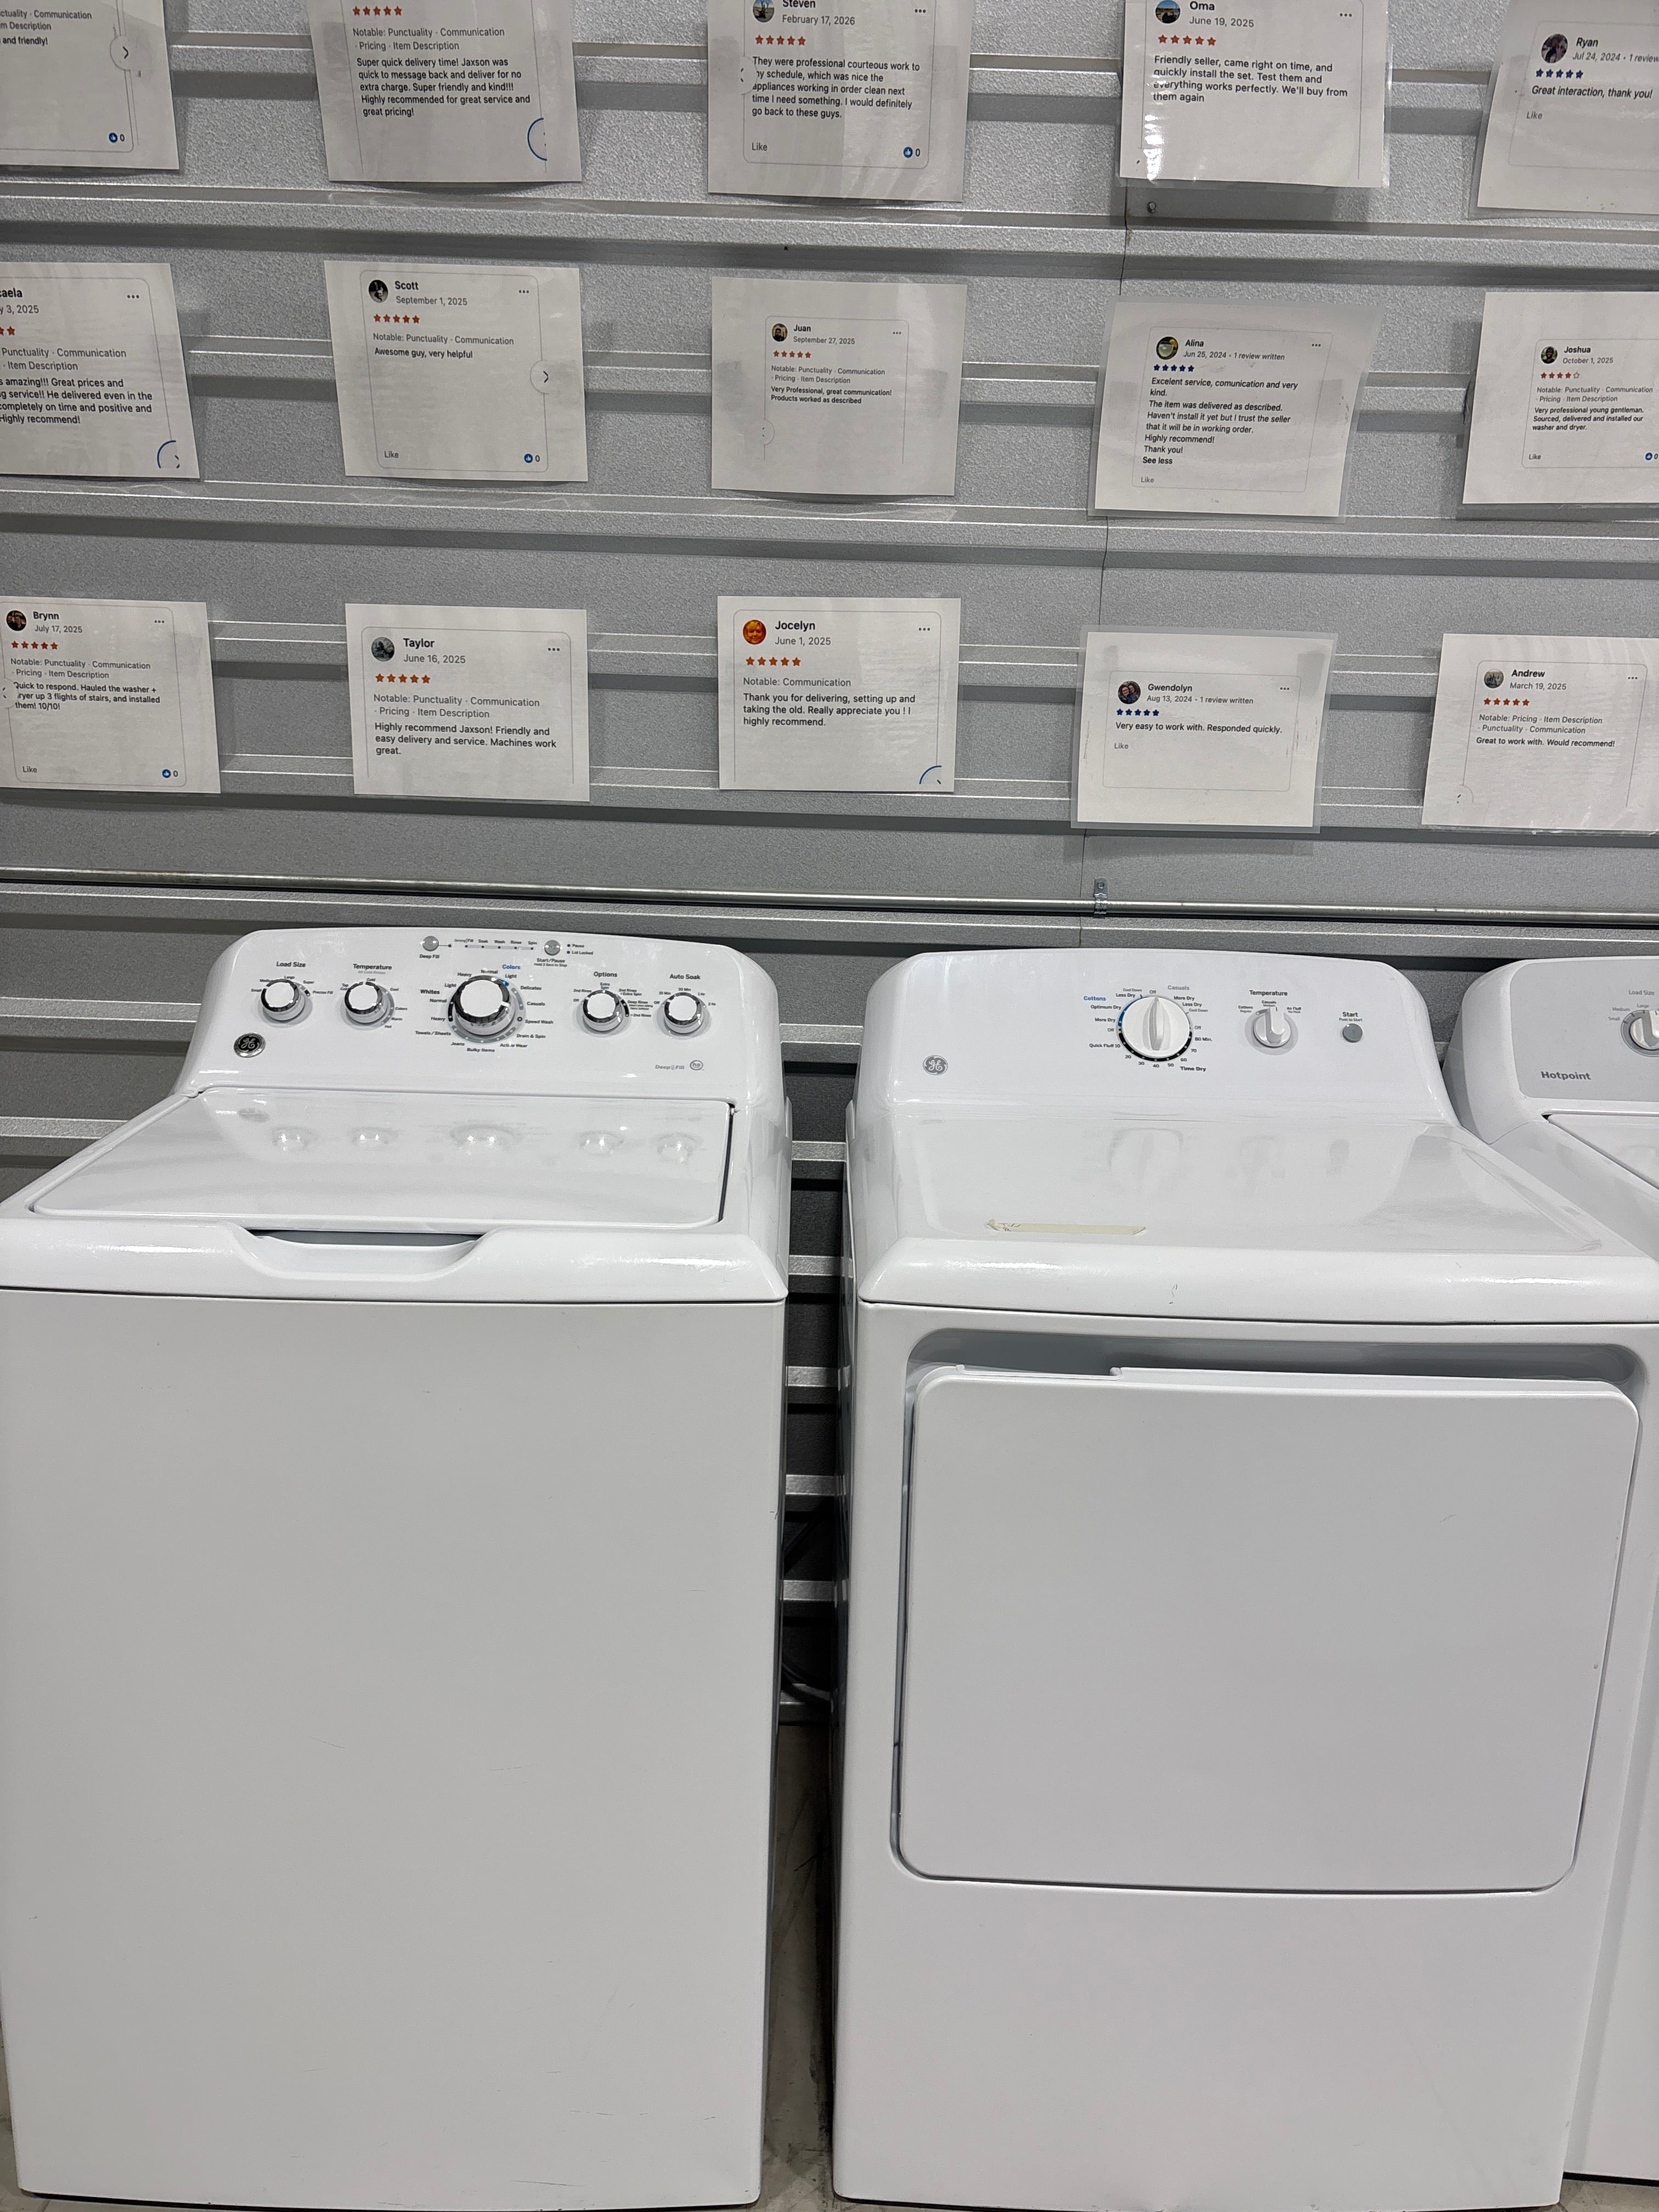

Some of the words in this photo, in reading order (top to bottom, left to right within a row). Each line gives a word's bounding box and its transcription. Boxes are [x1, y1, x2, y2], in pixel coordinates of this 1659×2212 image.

[783, 0, 815, 8] Steven
[1190, 1, 1215, 10] Oma
[782, 14, 819, 25] February
[821, 16, 831, 26] 17,
[834, 16, 855, 25] 2026
[1189, 16, 1211, 25] June
[1215, 18, 1227, 27] 19,
[1231, 18, 1254, 27] 2025
[2, 36, 16, 44] and
[18, 36, 48, 47] friendly!
[1576, 37, 1598, 48] Ryan
[357, 58, 379, 68] Super
[381, 58, 403, 68] quick
[405, 58, 436, 68] delivery
[438, 58, 459, 66] time!
[461, 58, 490, 66] Jaxson
[1155, 55, 1192, 66] Friendly
[1194, 57, 1221, 67] seller,
[1252, 60, 1273, 70] right
[1290, 61, 1312, 72] time,
[1316, 64, 1333, 72] and
[1532, 85, 1556, 95] Great
[1558, 86, 1605, 98] interaction,
[1608, 88, 1632, 98] thank
[1633, 89, 1653, 99] you!
[363, 108, 383, 117] great
[385, 107, 414, 117] pricing!
[752, 108, 762, 116] go
[765, 107, 783, 116] back
[786, 108, 794, 116] to
[796, 108, 819, 117] these
[821, 111, 842, 120] guys.
[752, 142, 768, 151] Like
[915, 148, 921, 157] 0
[394, 281, 419, 290] Scott
[396, 296, 437, 305] September
[439, 297, 445, 306] 1,
[448, 297, 467, 306] 2025
[2, 348, 49, 358] Punctuality
[57, 348, 126, 357] Communication
[375, 347, 409, 356] Awesome
[411, 350, 427, 358] guy,
[447, 349, 473, 359] helpful
[1144, 445, 1166, 453] Thank
[1167, 447, 1183, 455] you!
[33, 611, 59, 621] Brynn
[35, 625, 49, 633] July
[52, 625, 61, 634] 17,
[775, 620, 815, 632] Jocelyn
[403, 638, 435, 650] Taylor
[775, 636, 796, 645] June
[799, 637, 805, 646] 1,
[809, 637, 831, 645] 2025
[403, 654, 425, 662] June
[427, 654, 439, 664] 16,
[443, 655, 466, 663] 2025
[1511, 669, 1545, 678] Andrew
[743, 677, 780, 686] Notable:
[783, 678, 851, 686] Communication
[1535, 682, 1545, 691] 19,
[1148, 684, 1192, 693] Gwendolyn
[38, 702, 60, 711] 10/10!
[744, 716, 770, 727] highly
[772, 718, 826, 726] recommend.
[375, 722, 403, 732] Highly
[459, 725, 493, 733] Jaxson!
[496, 726, 531, 737] Friendly
[533, 727, 550, 736] and
[1116, 722, 1133, 731] Very
[1207, 724, 1251, 733] Responded
[1253, 725, 1282, 735] quickly.
[376, 747, 401, 755] great.
[1541, 1071, 1591, 1080] Hotpoint
